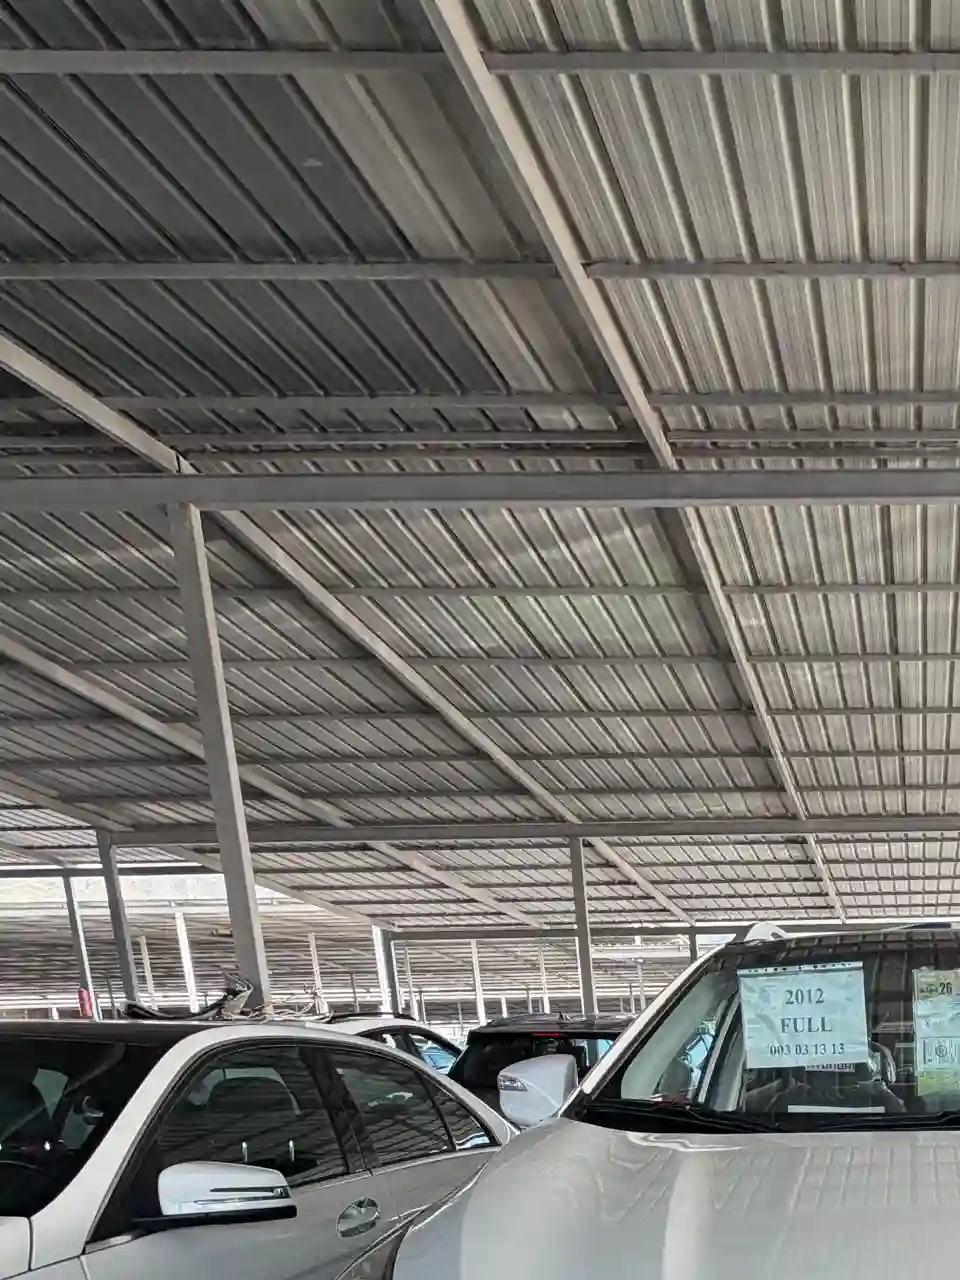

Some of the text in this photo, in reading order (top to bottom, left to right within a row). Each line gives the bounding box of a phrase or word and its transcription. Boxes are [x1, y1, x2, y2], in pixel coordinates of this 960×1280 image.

[785, 988, 825, 1005] 2012
[939, 981, 953, 995] 26
[780, 1016, 833, 1033] FULL
